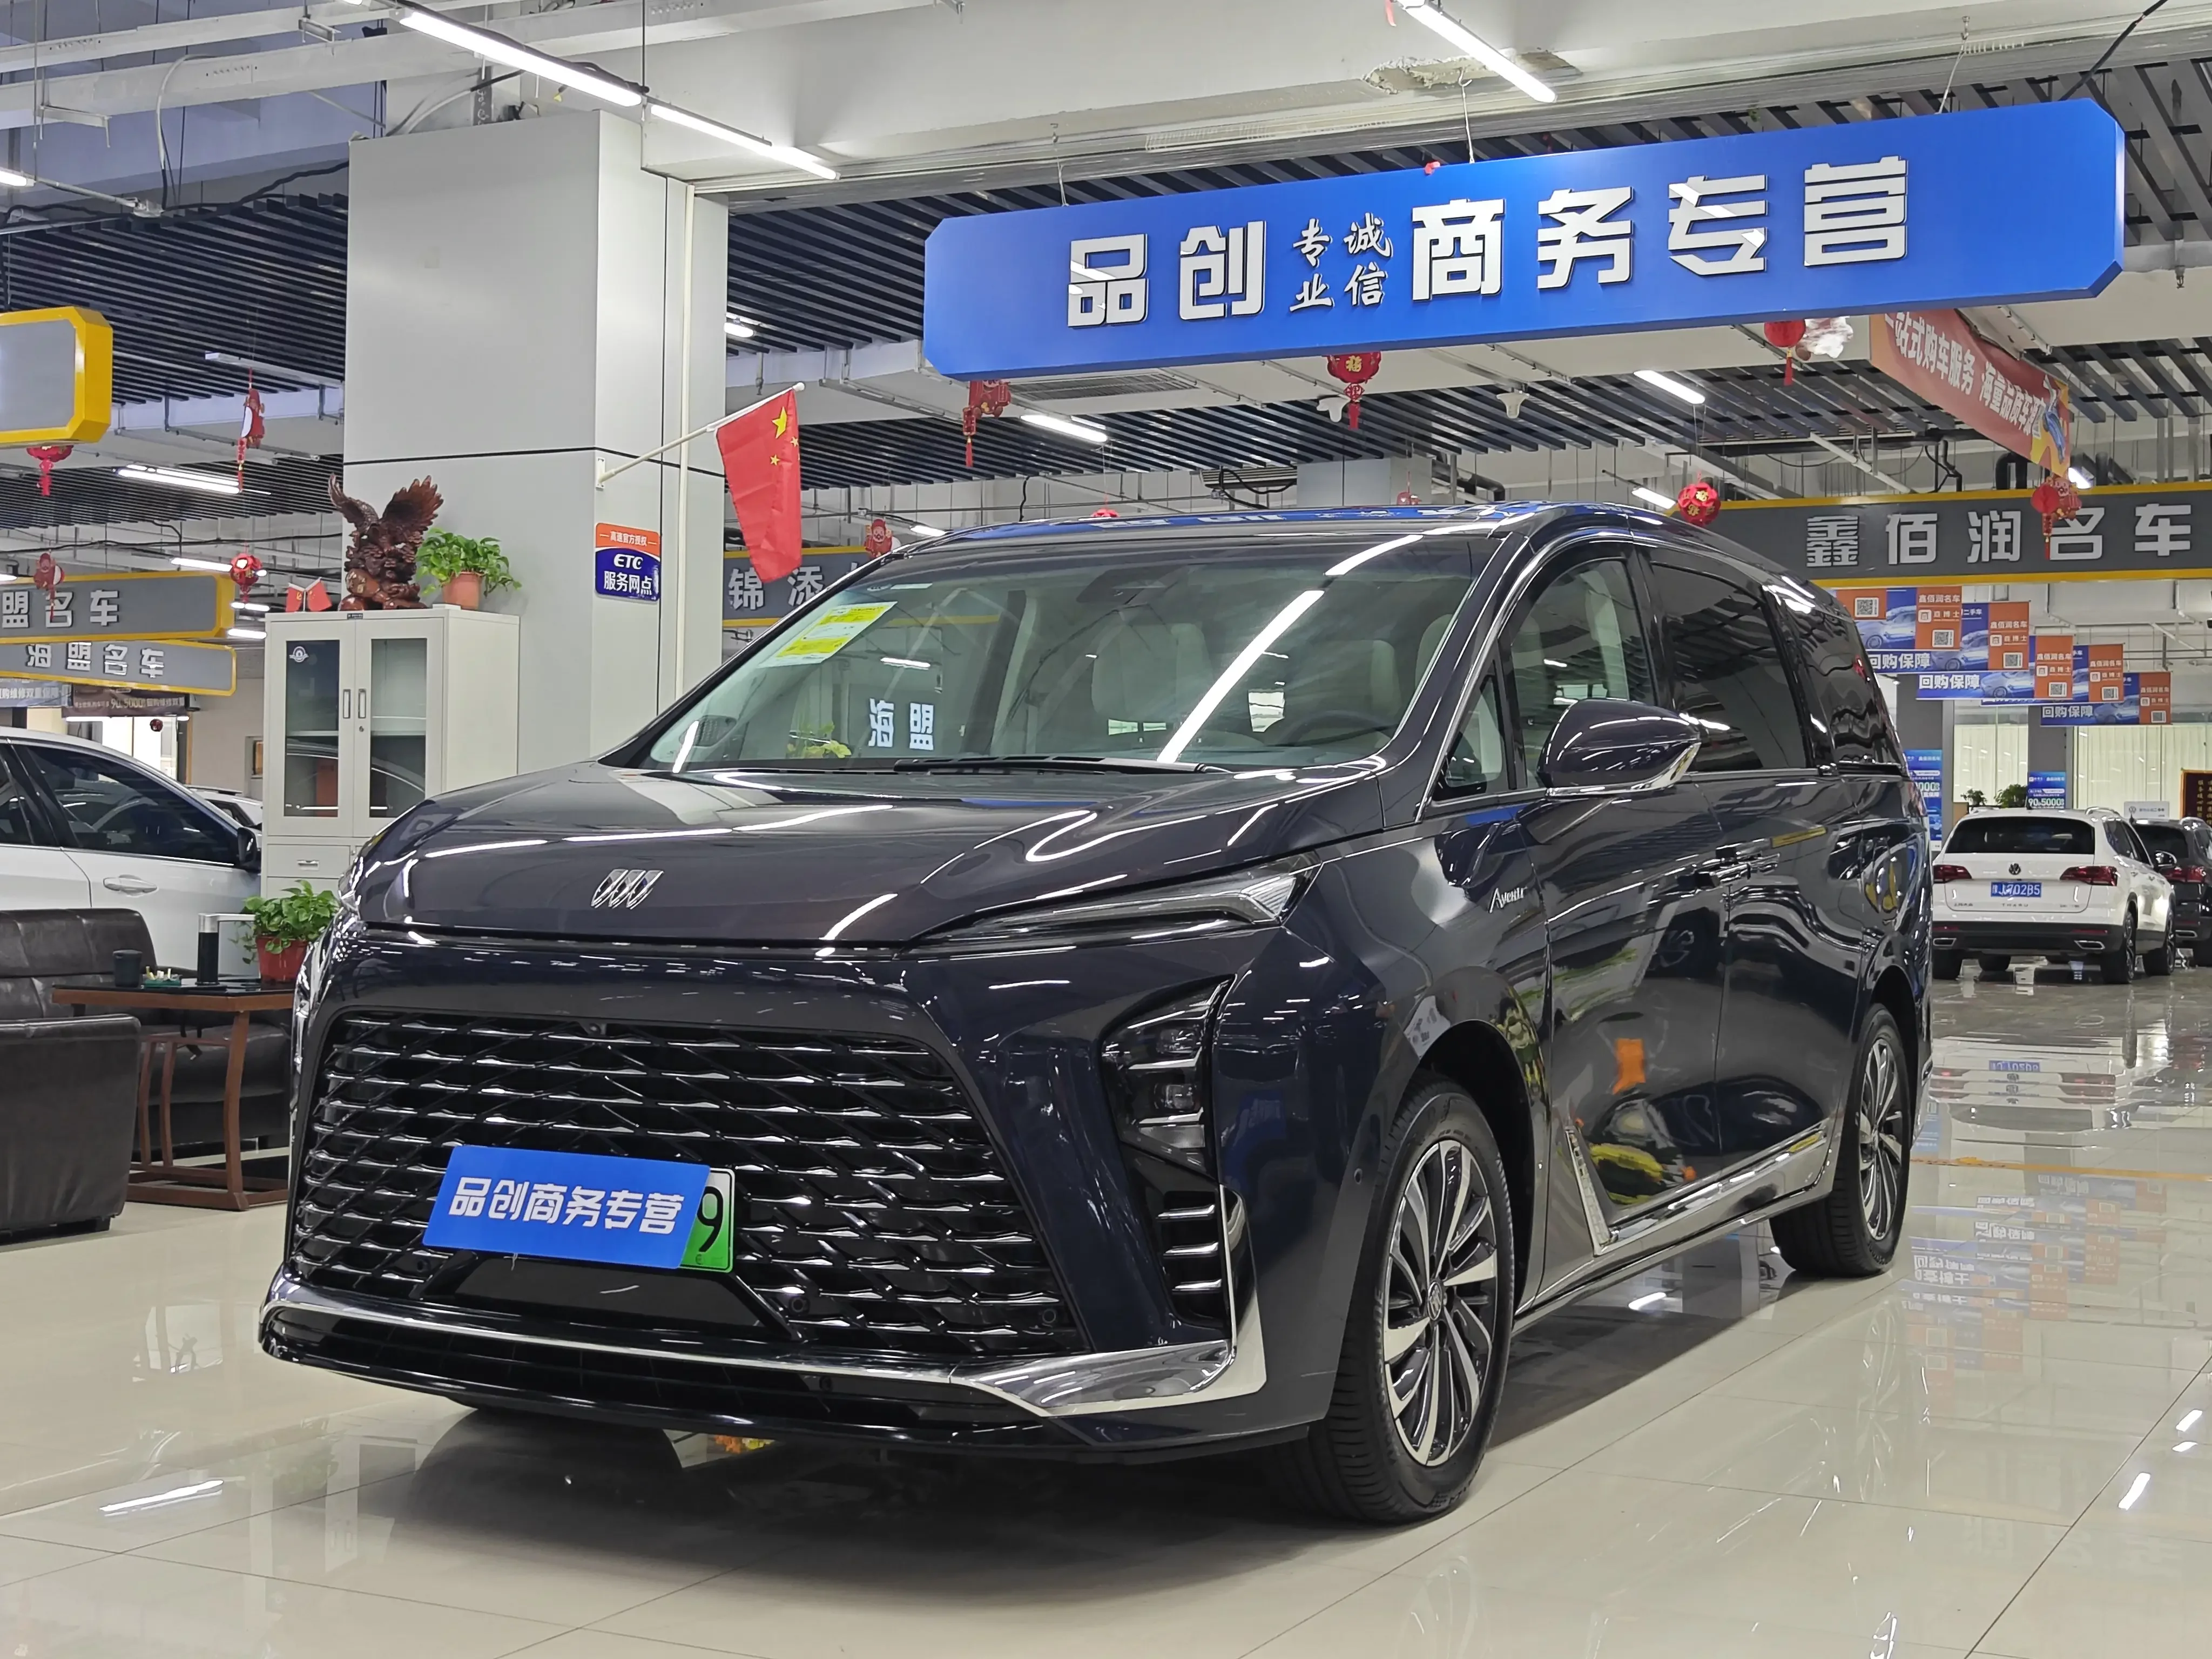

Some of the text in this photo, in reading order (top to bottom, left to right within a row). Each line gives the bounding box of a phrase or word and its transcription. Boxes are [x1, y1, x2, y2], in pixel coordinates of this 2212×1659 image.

[1412, 156, 1908, 301] 商务专营
[1067, 220, 1267, 327] 品创
[1885, 312, 1975, 395] 一站式购车服务
[610, 531, 647, 547] 高速官方授权
[1806, 504, 2191, 567] 鑫佰润名车
[613, 554, 644, 570] ETC
[604, 570, 653, 596] 服务网点
[728, 562, 859, 610] 锦添
[1919, 594, 1961, 603] 鑫佰润名车
[2, 590, 118, 628] 盟名车
[1869, 653, 1931, 669] 回购保障
[1919, 674, 1980, 690] 回购保障
[2042, 705, 2093, 718] 回购保障
[448, 1177, 685, 1235] 品创商务专营
[697, 1186, 724, 1252] 9
